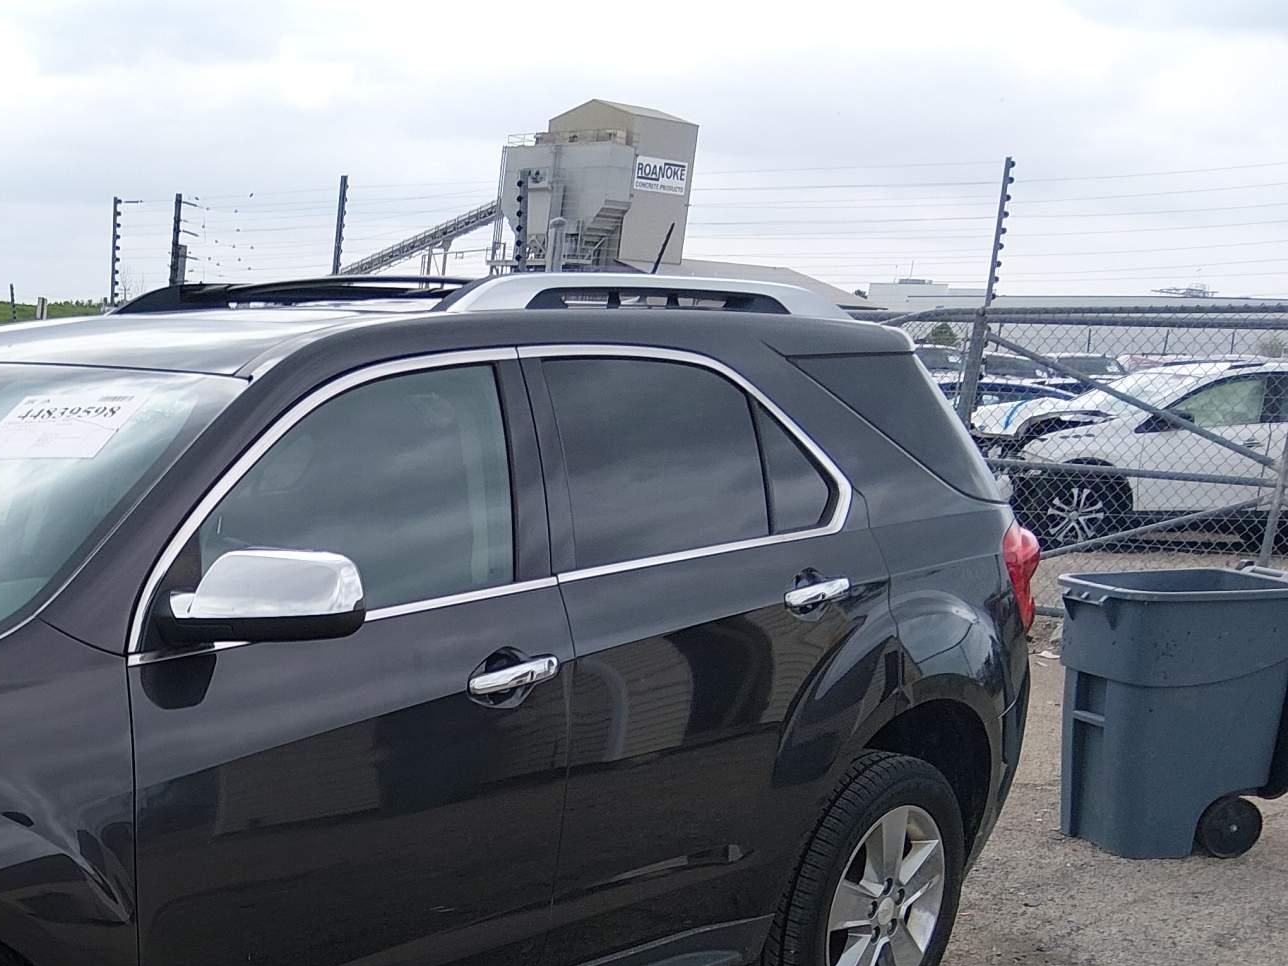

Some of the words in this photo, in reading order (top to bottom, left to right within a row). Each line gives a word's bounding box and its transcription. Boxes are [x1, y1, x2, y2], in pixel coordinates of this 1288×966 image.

[636, 162, 686, 181] ROANOKE
[635, 181, 659, 190] CONCRETE
[17, 405, 121, 421] 44839598
